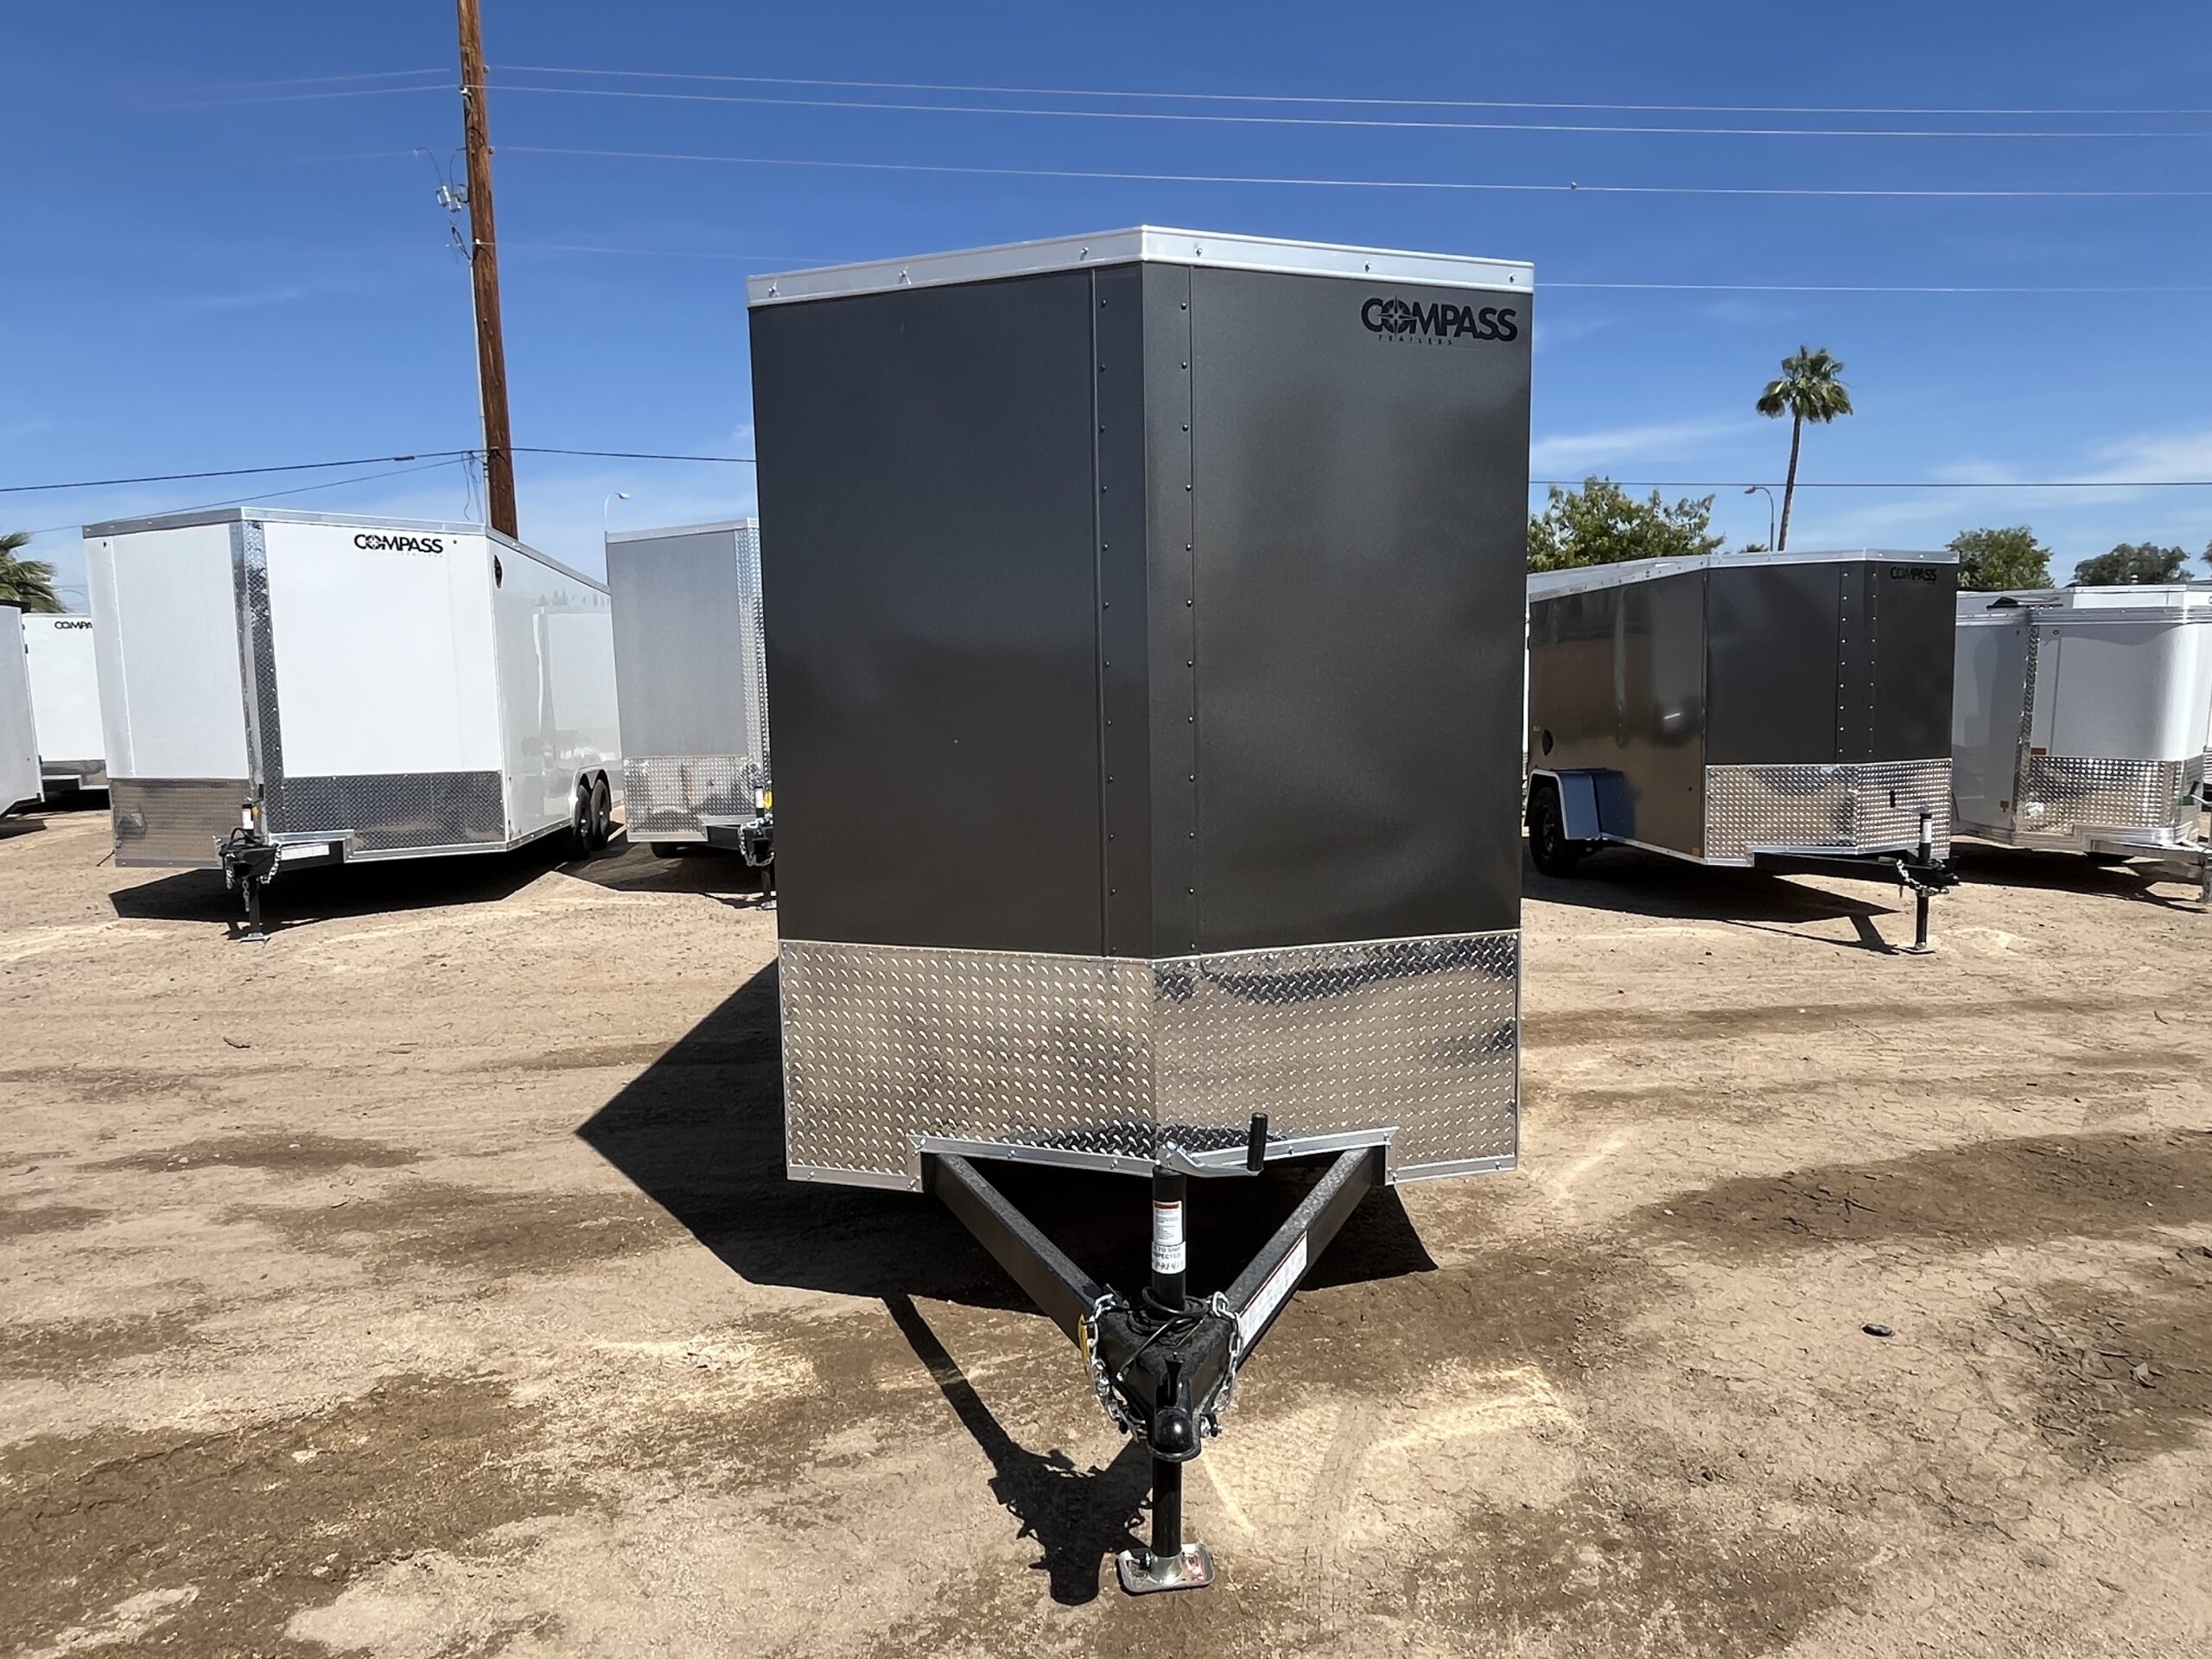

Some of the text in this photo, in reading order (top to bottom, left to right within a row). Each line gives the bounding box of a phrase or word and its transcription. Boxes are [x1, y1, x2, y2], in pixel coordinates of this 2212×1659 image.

[1361, 296, 1518, 342] COMPASS
[354, 534, 444, 554] COMPASS
[1890, 566, 1937, 582] COMPASS
